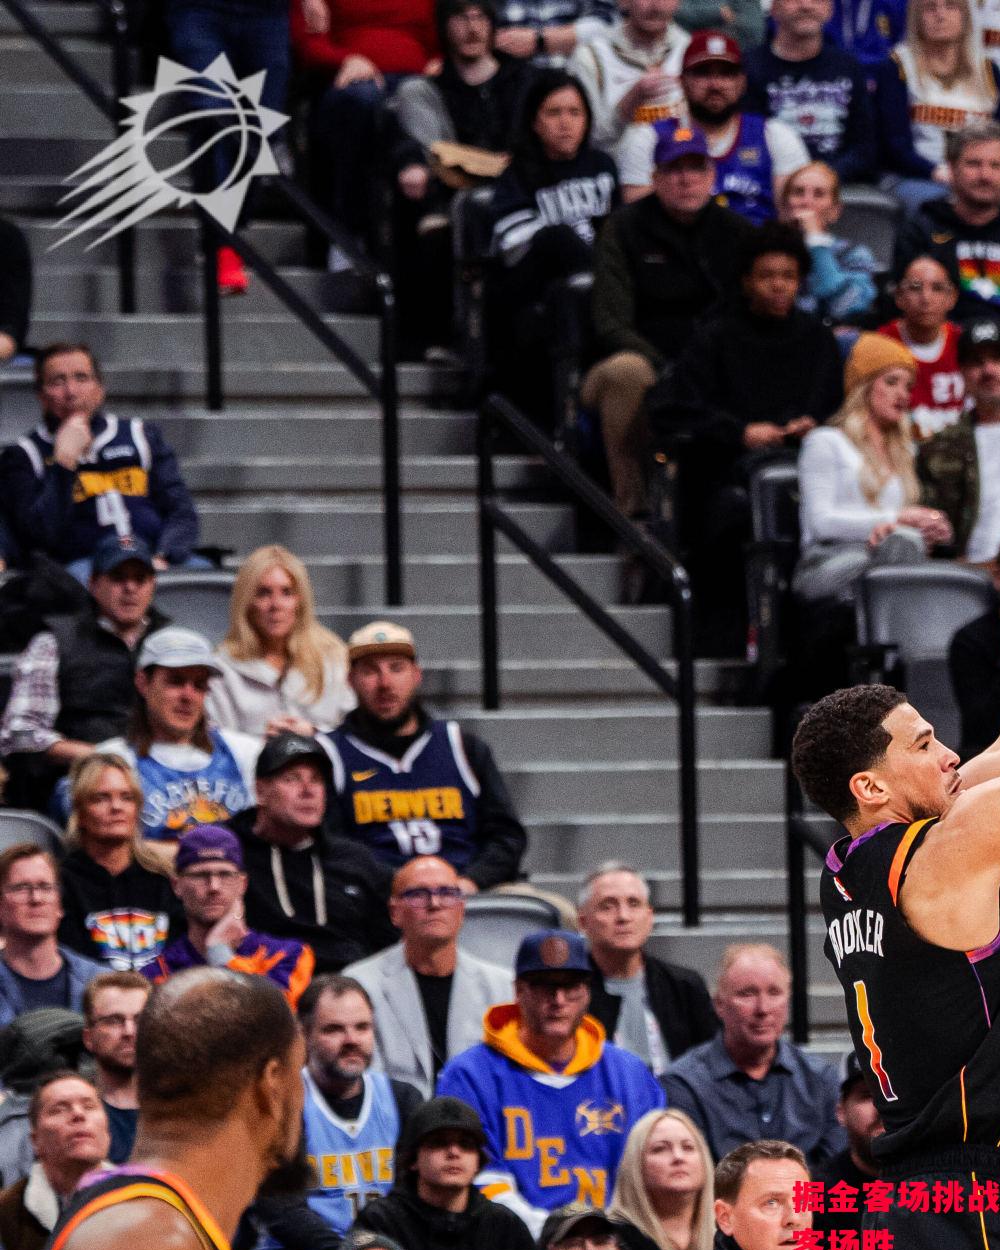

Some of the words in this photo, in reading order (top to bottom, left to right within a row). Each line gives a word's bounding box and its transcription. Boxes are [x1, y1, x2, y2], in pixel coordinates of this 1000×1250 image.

[352, 786, 465, 824] DENVER
[388, 818, 441, 854] 15
[853, 980, 899, 1102] 1
